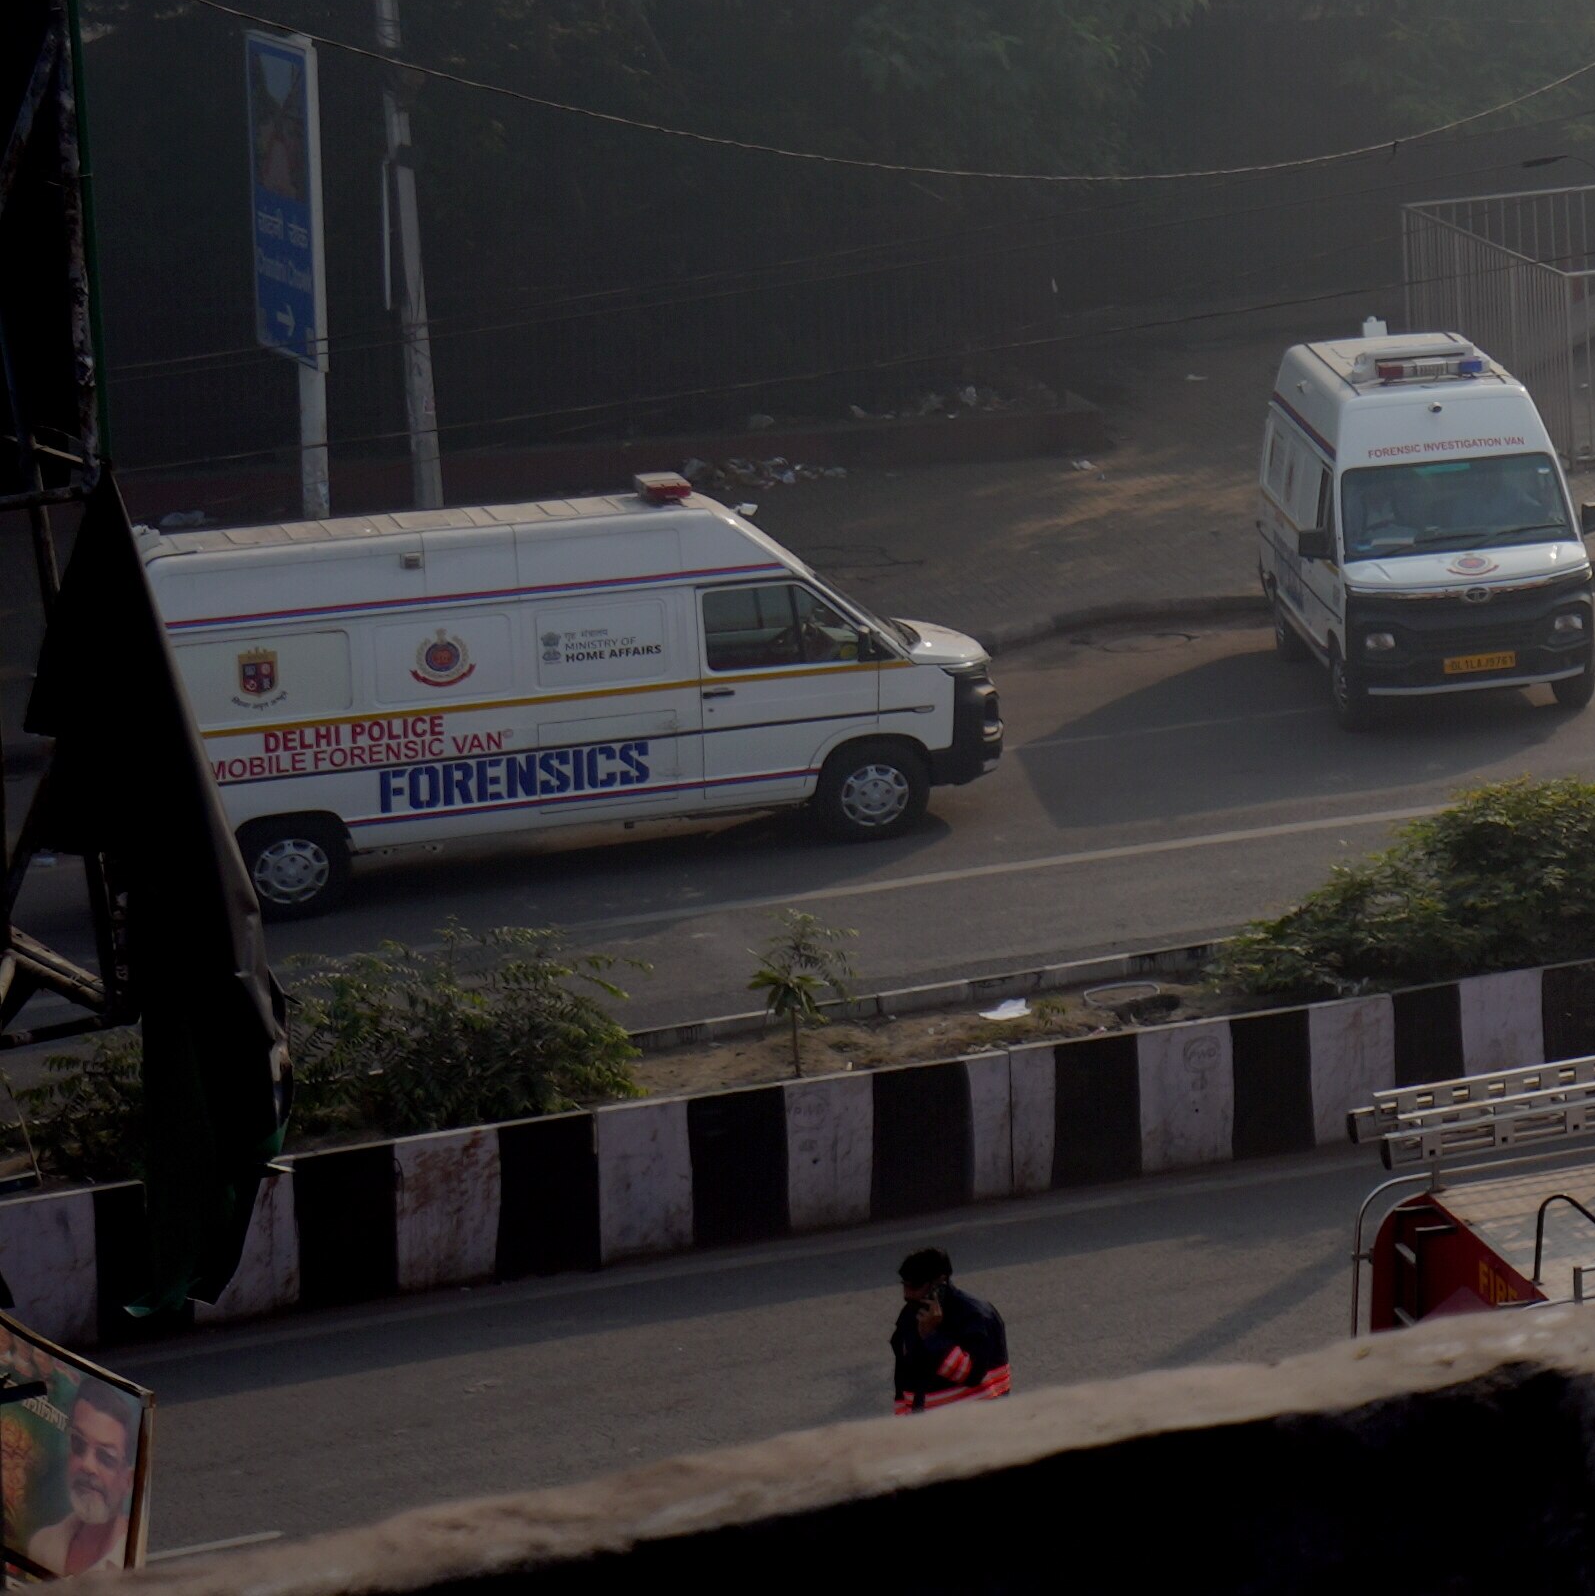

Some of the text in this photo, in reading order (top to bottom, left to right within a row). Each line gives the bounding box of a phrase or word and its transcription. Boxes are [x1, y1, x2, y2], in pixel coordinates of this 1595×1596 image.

[1368, 436, 1525, 459] FORENSIC INVESTIGATION VAN
[565, 636, 638, 652] MINISTRY OF
[565, 644, 662, 664] HOME AFFAIRS
[263, 715, 445, 755] DELHI POLICE
[212, 729, 503, 781] MOBILE FORENSIC VAN
[379, 741, 650, 814] FORENSICS
